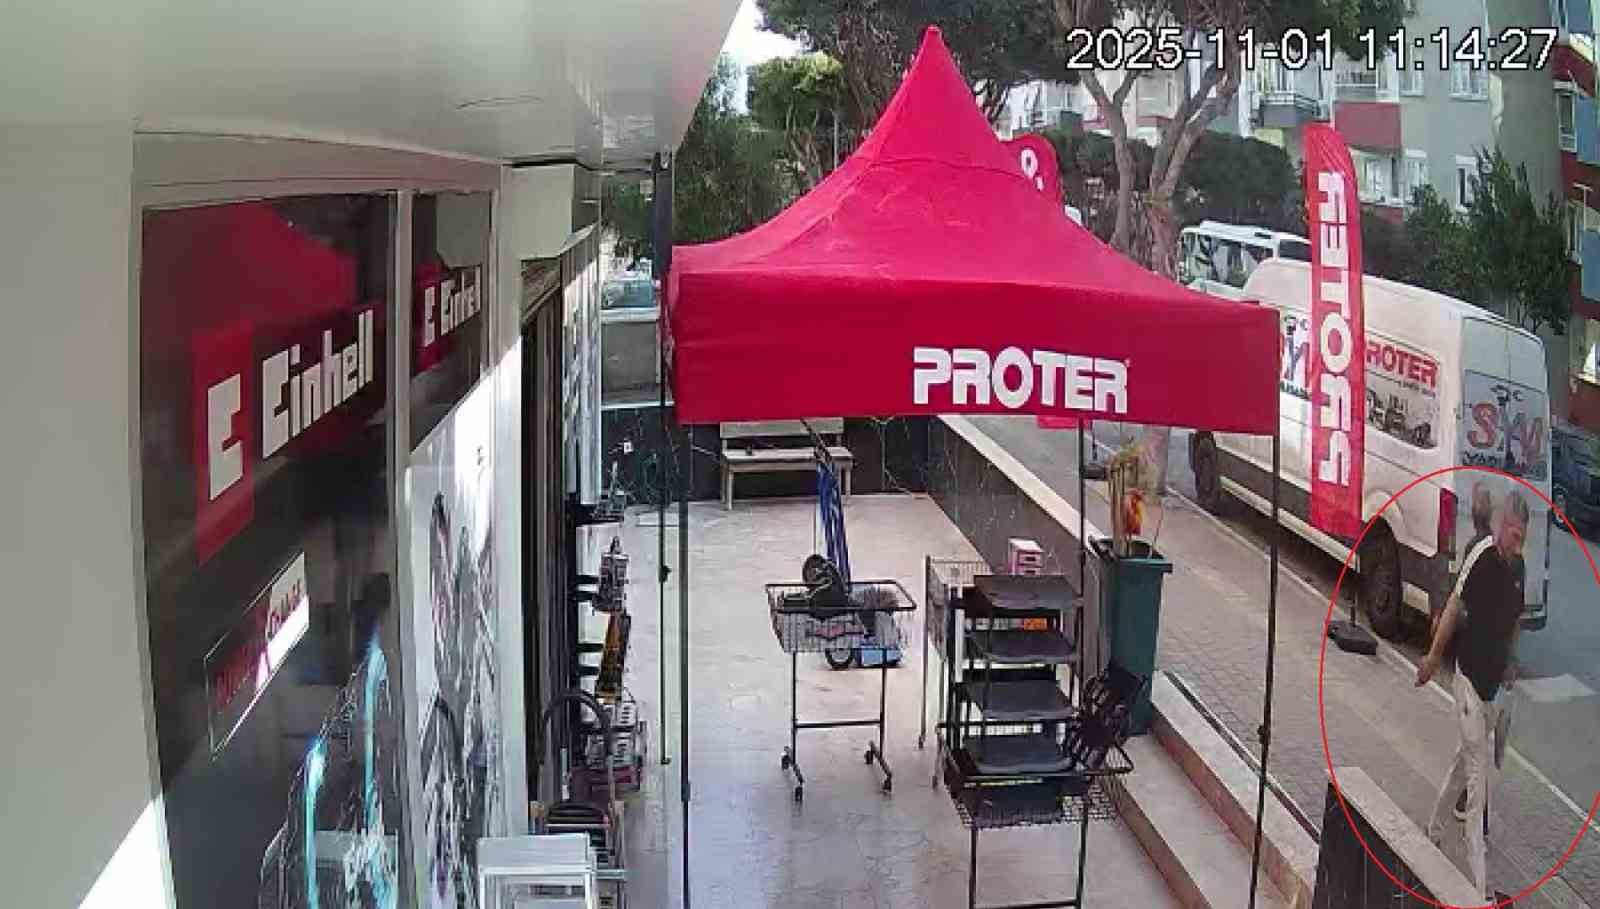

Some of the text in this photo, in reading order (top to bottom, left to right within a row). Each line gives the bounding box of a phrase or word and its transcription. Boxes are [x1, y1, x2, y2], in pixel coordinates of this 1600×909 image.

[262, 310, 374, 460] Einhell
[913, 346, 1128, 413] PROTER
[1366, 340, 1440, 389] ROTER
